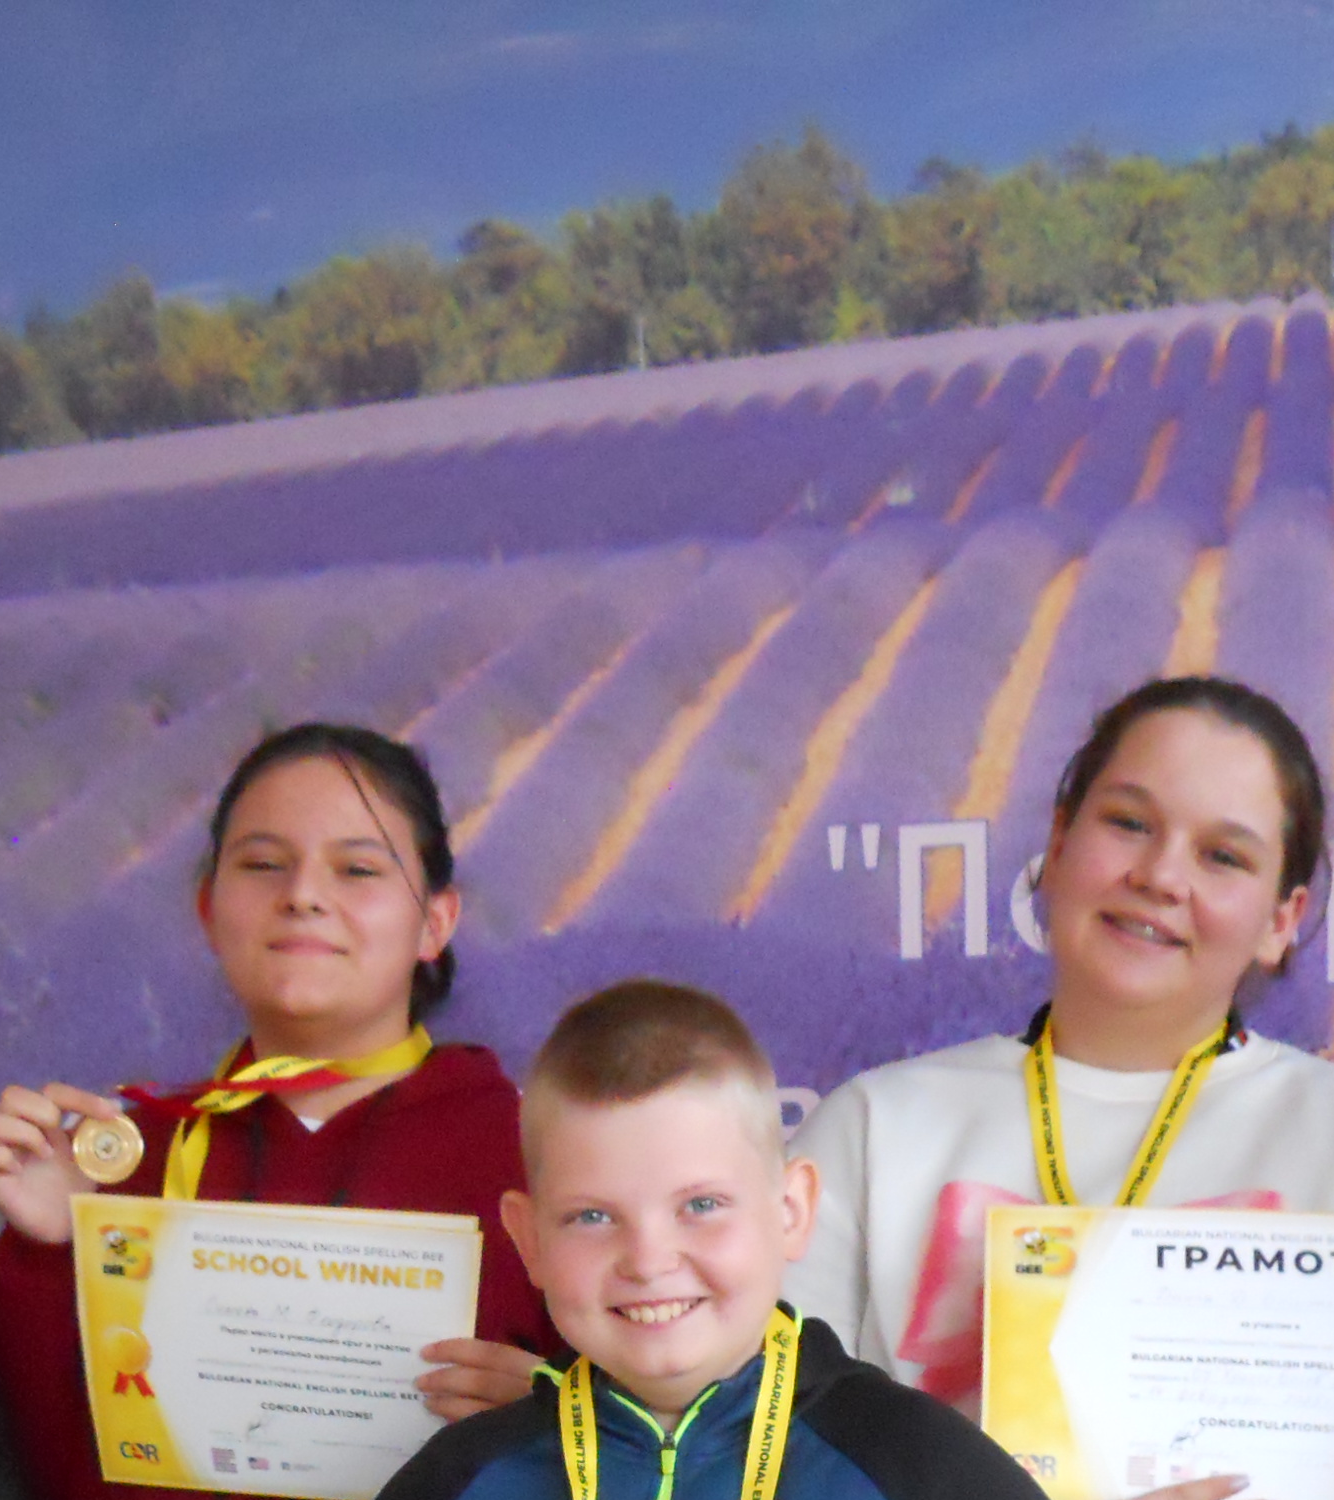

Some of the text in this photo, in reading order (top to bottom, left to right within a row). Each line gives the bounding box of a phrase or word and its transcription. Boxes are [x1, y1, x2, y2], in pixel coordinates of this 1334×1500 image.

[192, 1248, 445, 1291] SCHOOL WINNER
[572, 1402, 584, 1428] BEE
[771, 1352, 786, 1422] BULGARIAN
[573, 1431, 589, 1487] SPELLING
[756, 1425, 774, 1487] NATIONAL
